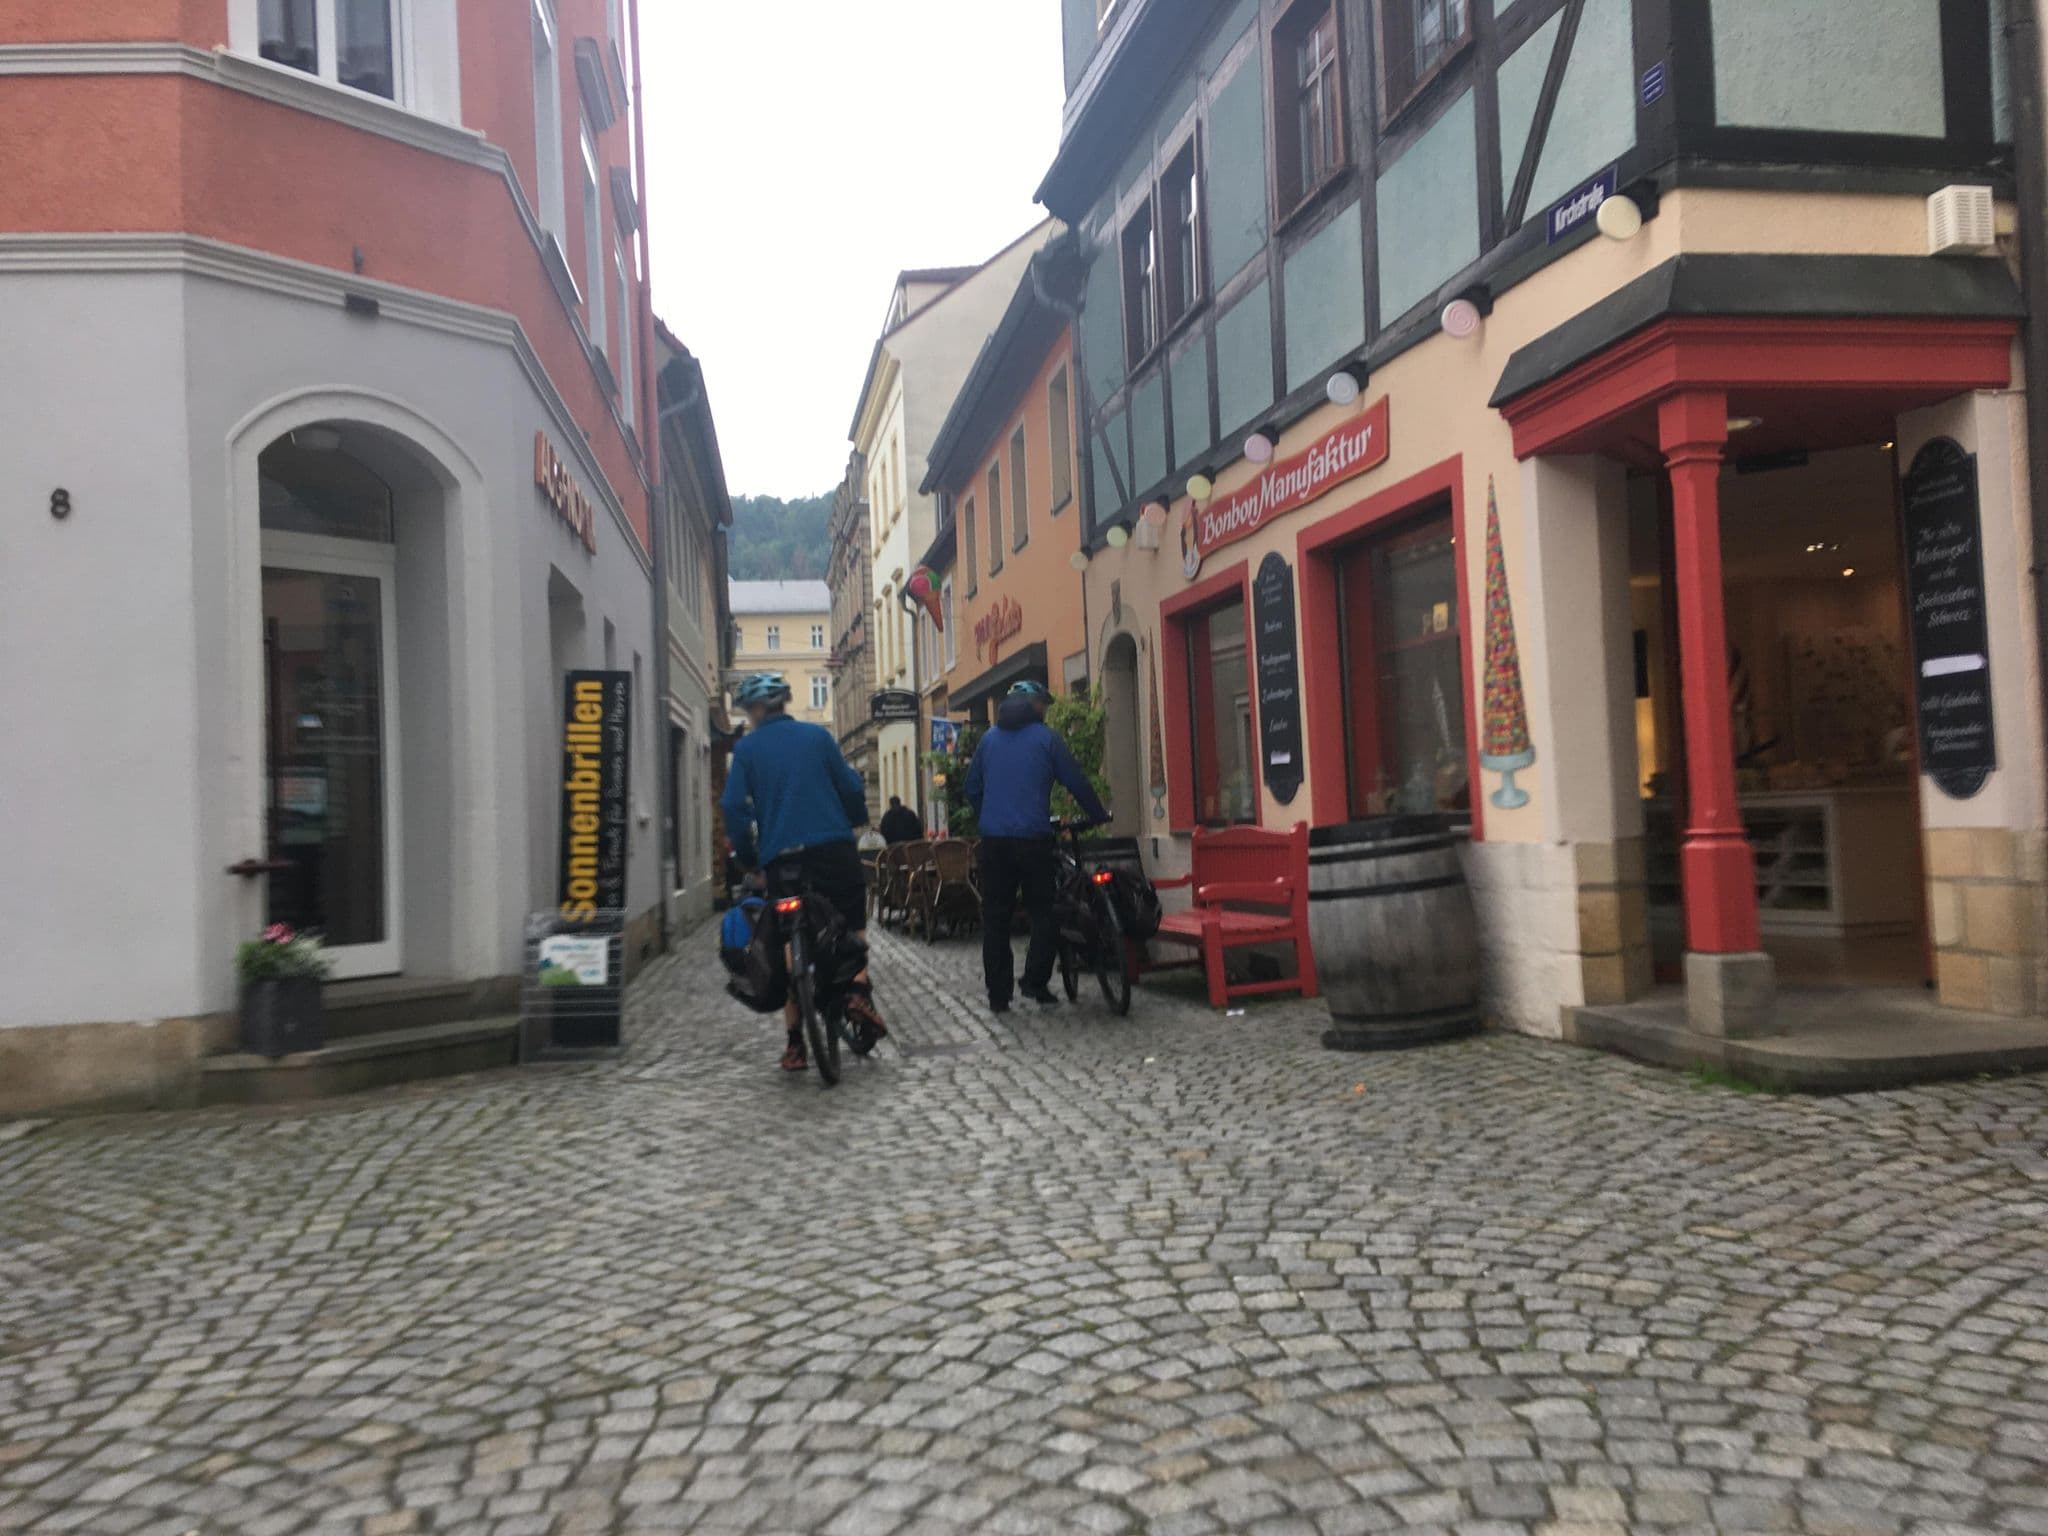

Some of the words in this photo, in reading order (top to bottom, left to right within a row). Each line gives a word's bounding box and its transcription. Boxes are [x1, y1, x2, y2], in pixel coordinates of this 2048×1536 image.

[50, 487, 71, 519] 8
[1202, 495, 1259, 545] Bonbon
[1248, 423, 1373, 527] Manufaktur
[558, 679, 605, 924] Sonnenbrillen
